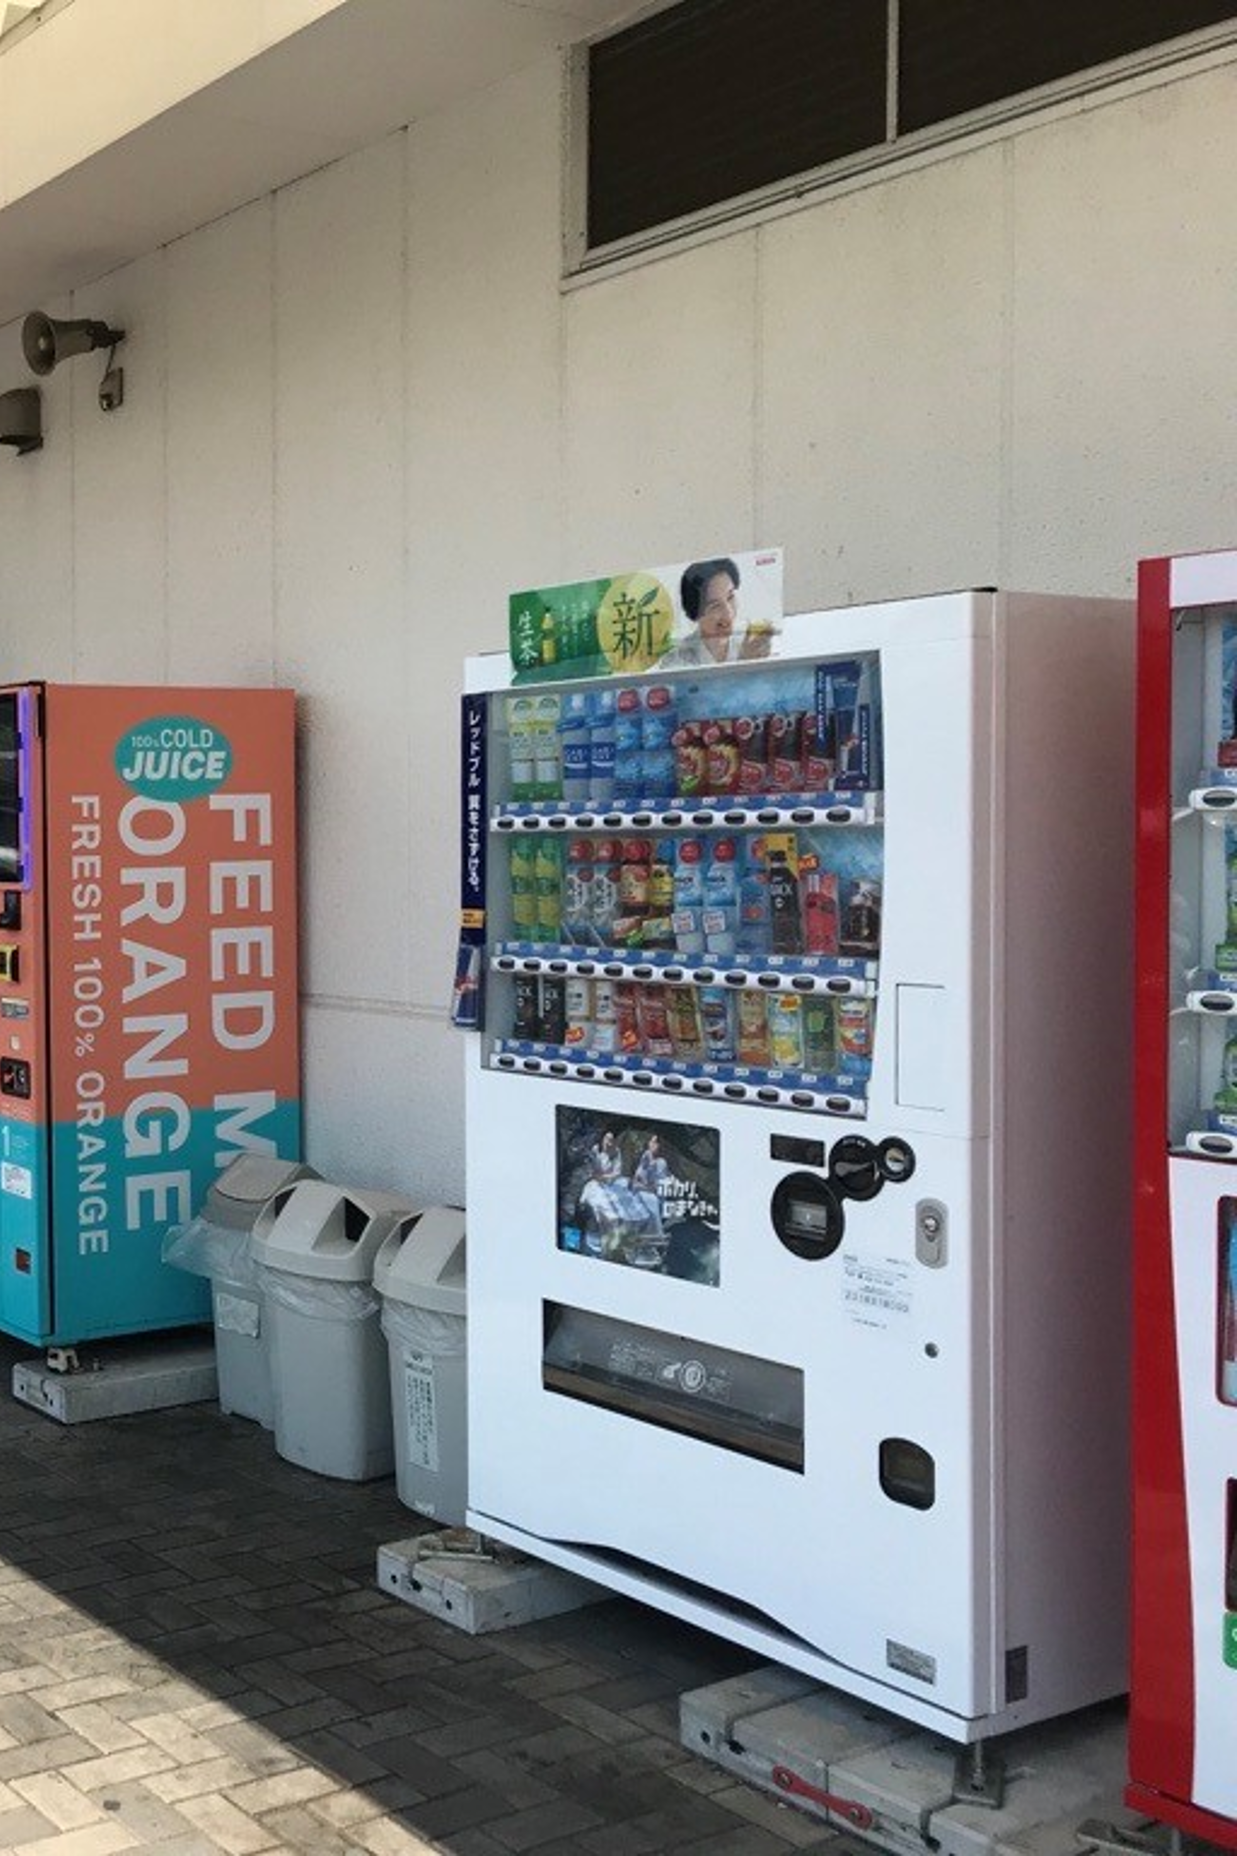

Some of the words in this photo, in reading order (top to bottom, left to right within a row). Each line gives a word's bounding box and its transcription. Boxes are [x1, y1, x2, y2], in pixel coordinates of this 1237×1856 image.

[516, 610, 538, 667] 生茶
[612, 588, 660, 660] 新
[122, 751, 227, 781] JUICE
[160, 728, 214, 748] COLD
[467, 710, 481, 787] レッドブル
[71, 794, 102, 941] FRESH
[208, 792, 276, 1051] FEED
[73, 957, 105, 1057] 100%
[118, 794, 192, 1231] ORANGE
[1, 1124, 11, 1157] 1
[75, 1071, 109, 1256] ORANGE
